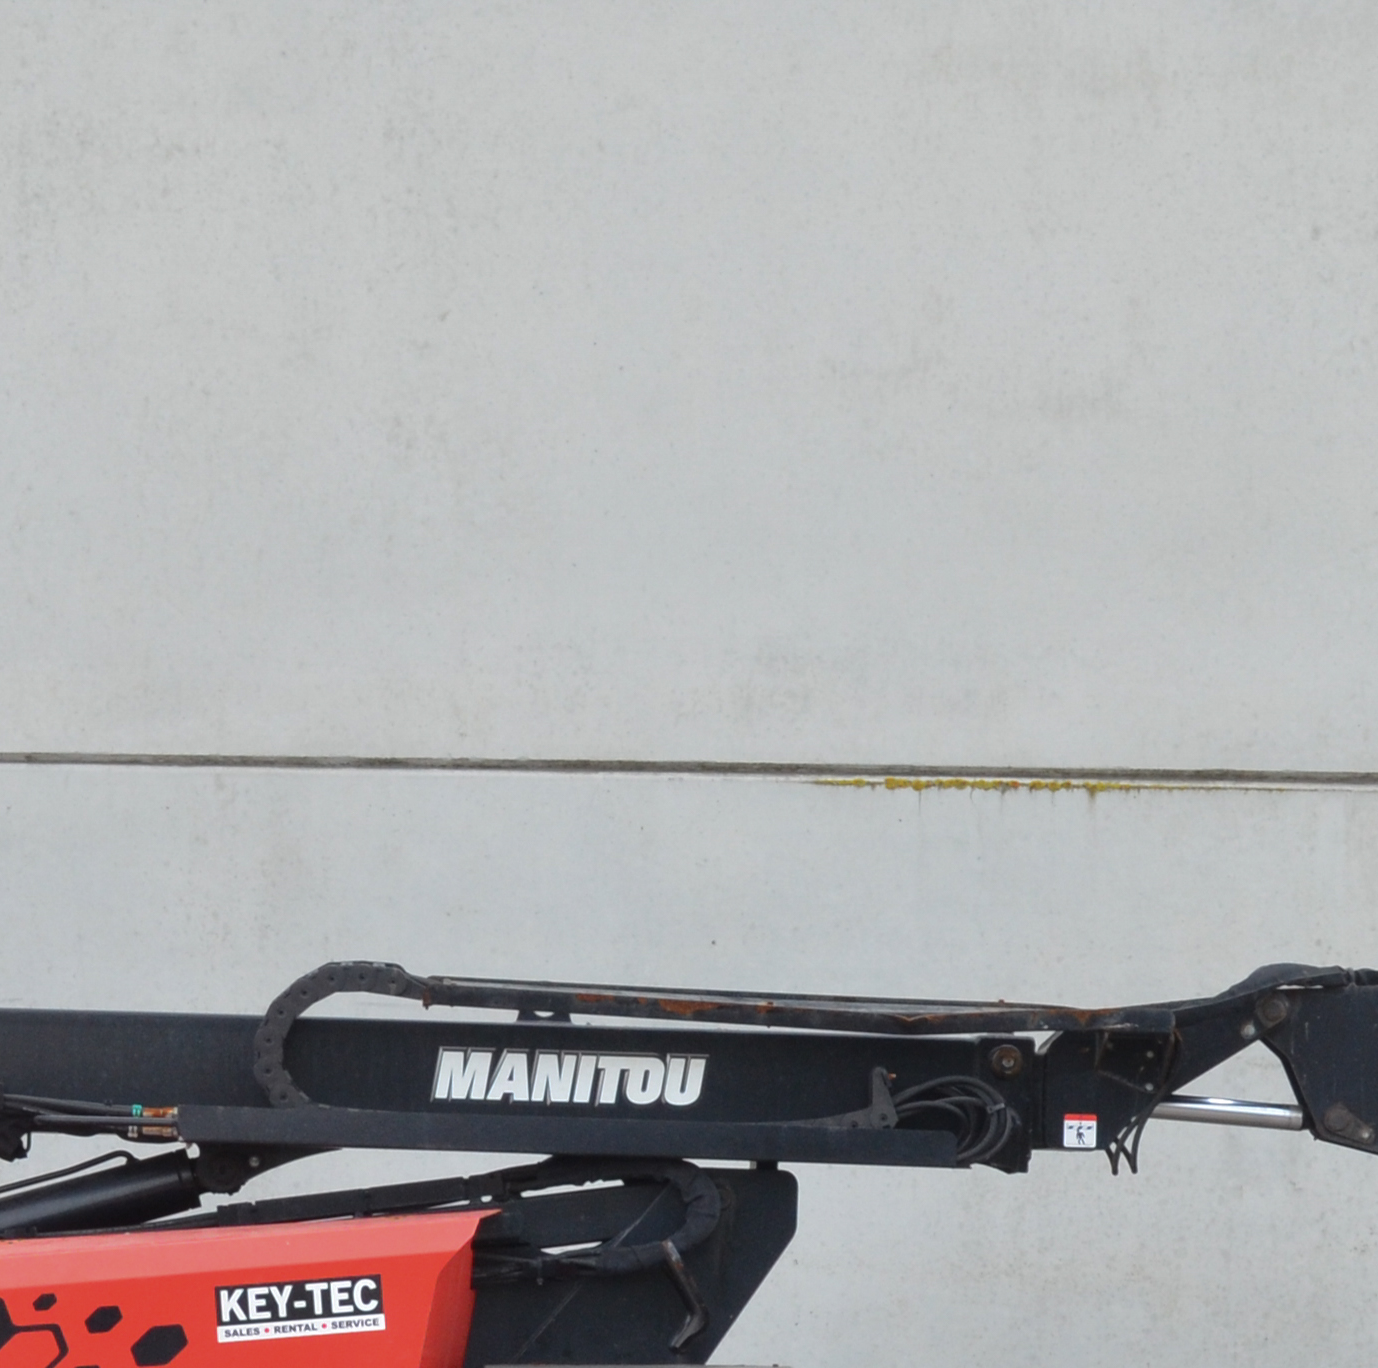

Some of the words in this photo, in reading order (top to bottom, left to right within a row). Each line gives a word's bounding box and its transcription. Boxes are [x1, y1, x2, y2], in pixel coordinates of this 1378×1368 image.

[431, 1046, 708, 1106] MANITOU
[220, 1278, 379, 1322] KEY-TEC
[224, 1327, 260, 1338] SALES
[274, 1323, 318, 1334] RENTAL
[331, 1317, 380, 1330] SERVICE
